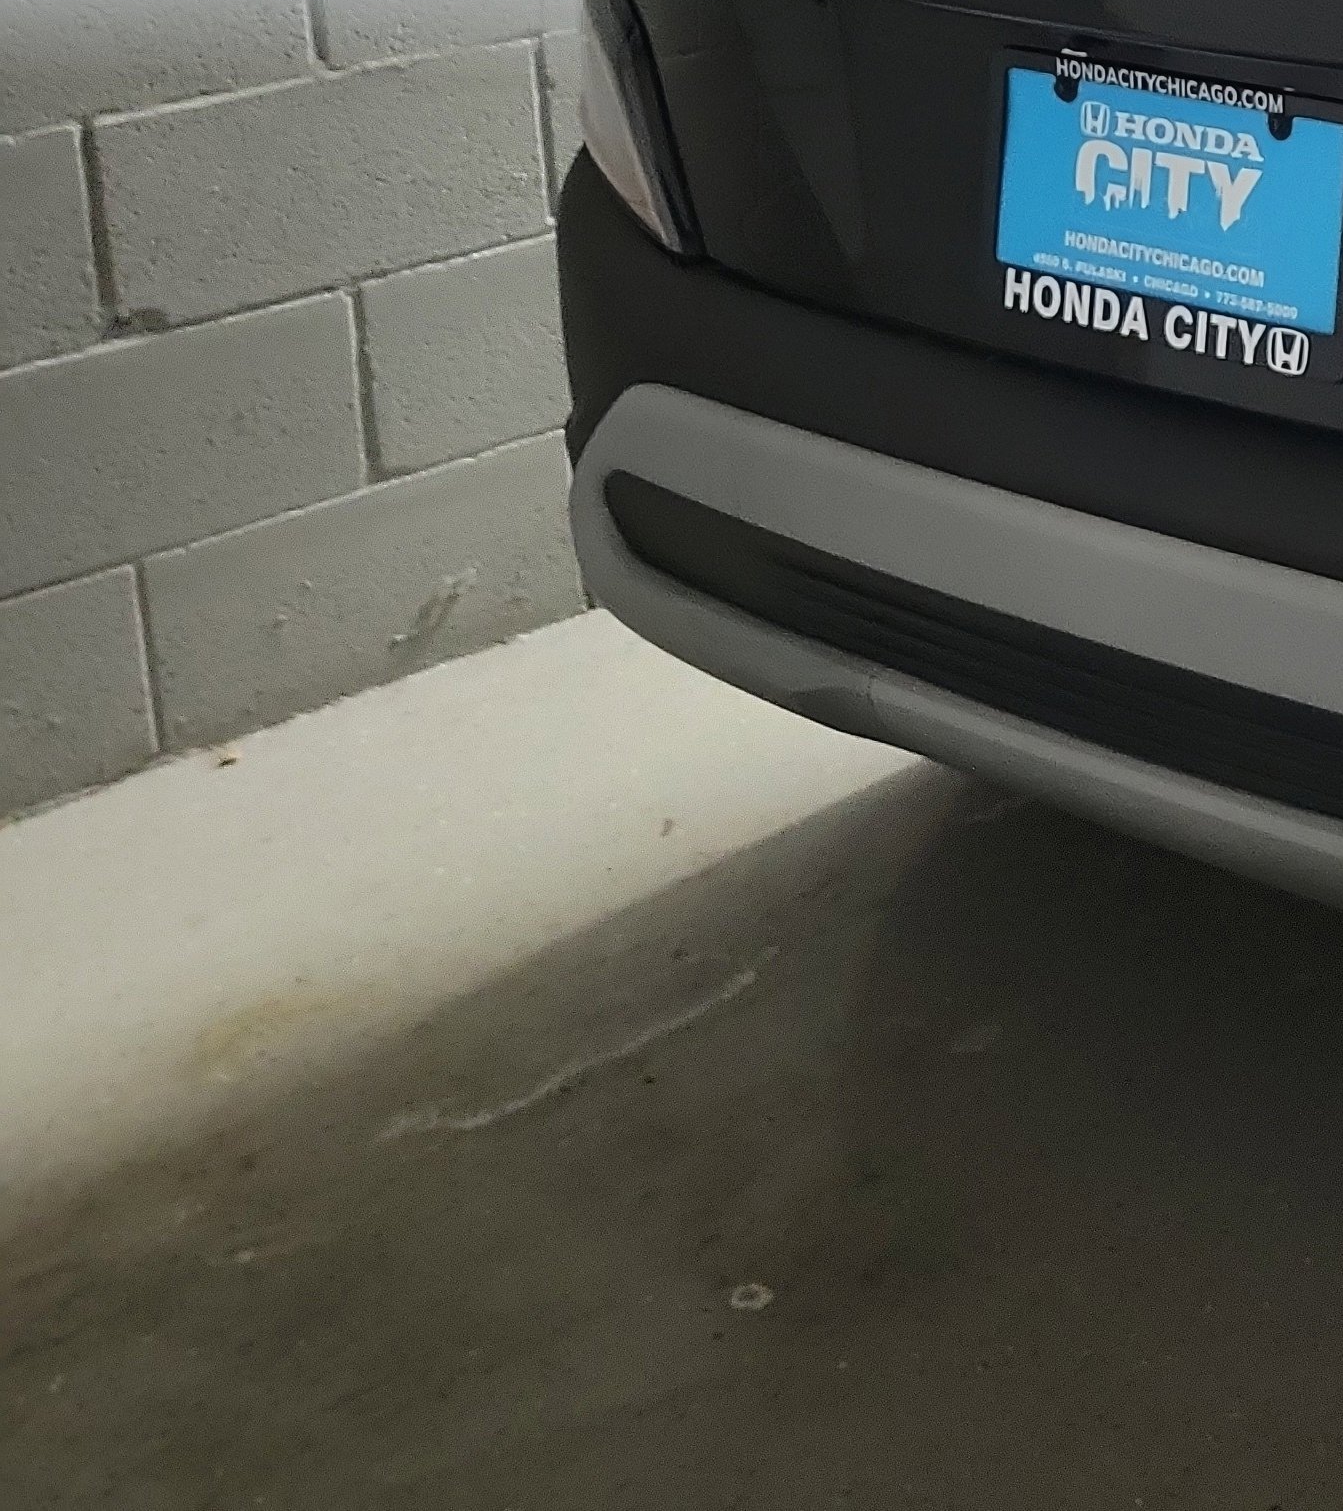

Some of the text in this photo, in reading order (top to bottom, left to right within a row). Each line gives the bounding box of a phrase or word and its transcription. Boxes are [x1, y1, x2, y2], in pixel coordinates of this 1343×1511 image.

[1056, 56, 1284, 113] HONDACITYCHICAGO.COM
[1114, 111, 1265, 162] HONDA
[1075, 139, 1264, 230] CITY
[1064, 229, 1265, 288] HONDACITYCHICAGO.COM
[1004, 266, 1267, 366] HONDA CITY
